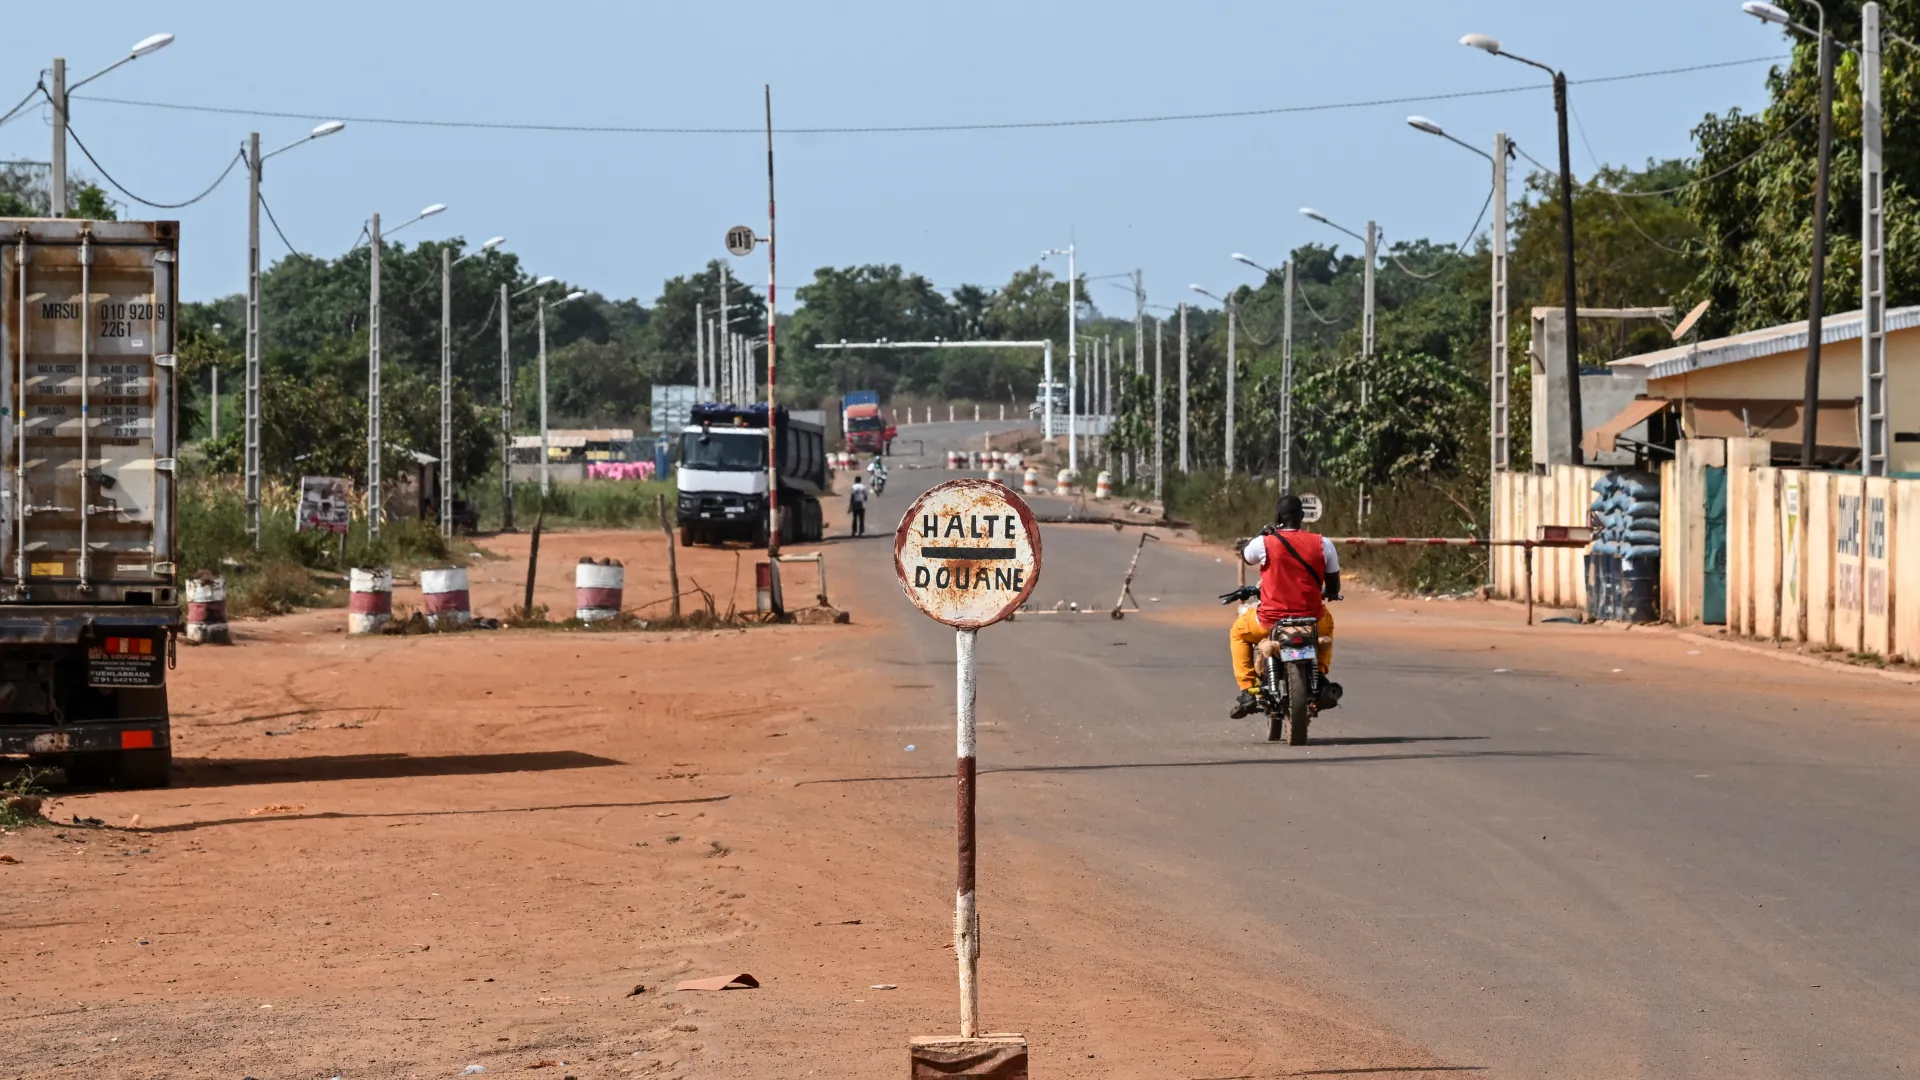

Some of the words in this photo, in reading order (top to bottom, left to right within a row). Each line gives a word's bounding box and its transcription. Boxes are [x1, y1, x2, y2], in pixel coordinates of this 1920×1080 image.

[42, 303, 79, 319] MRSU
[101, 304, 125, 320] 010
[129, 304, 153, 320] 920
[157, 304, 165, 320] 9
[101, 321, 132, 338] 22G1
[923, 514, 1016, 540] HALTE
[915, 565, 1024, 593] DOUANE
